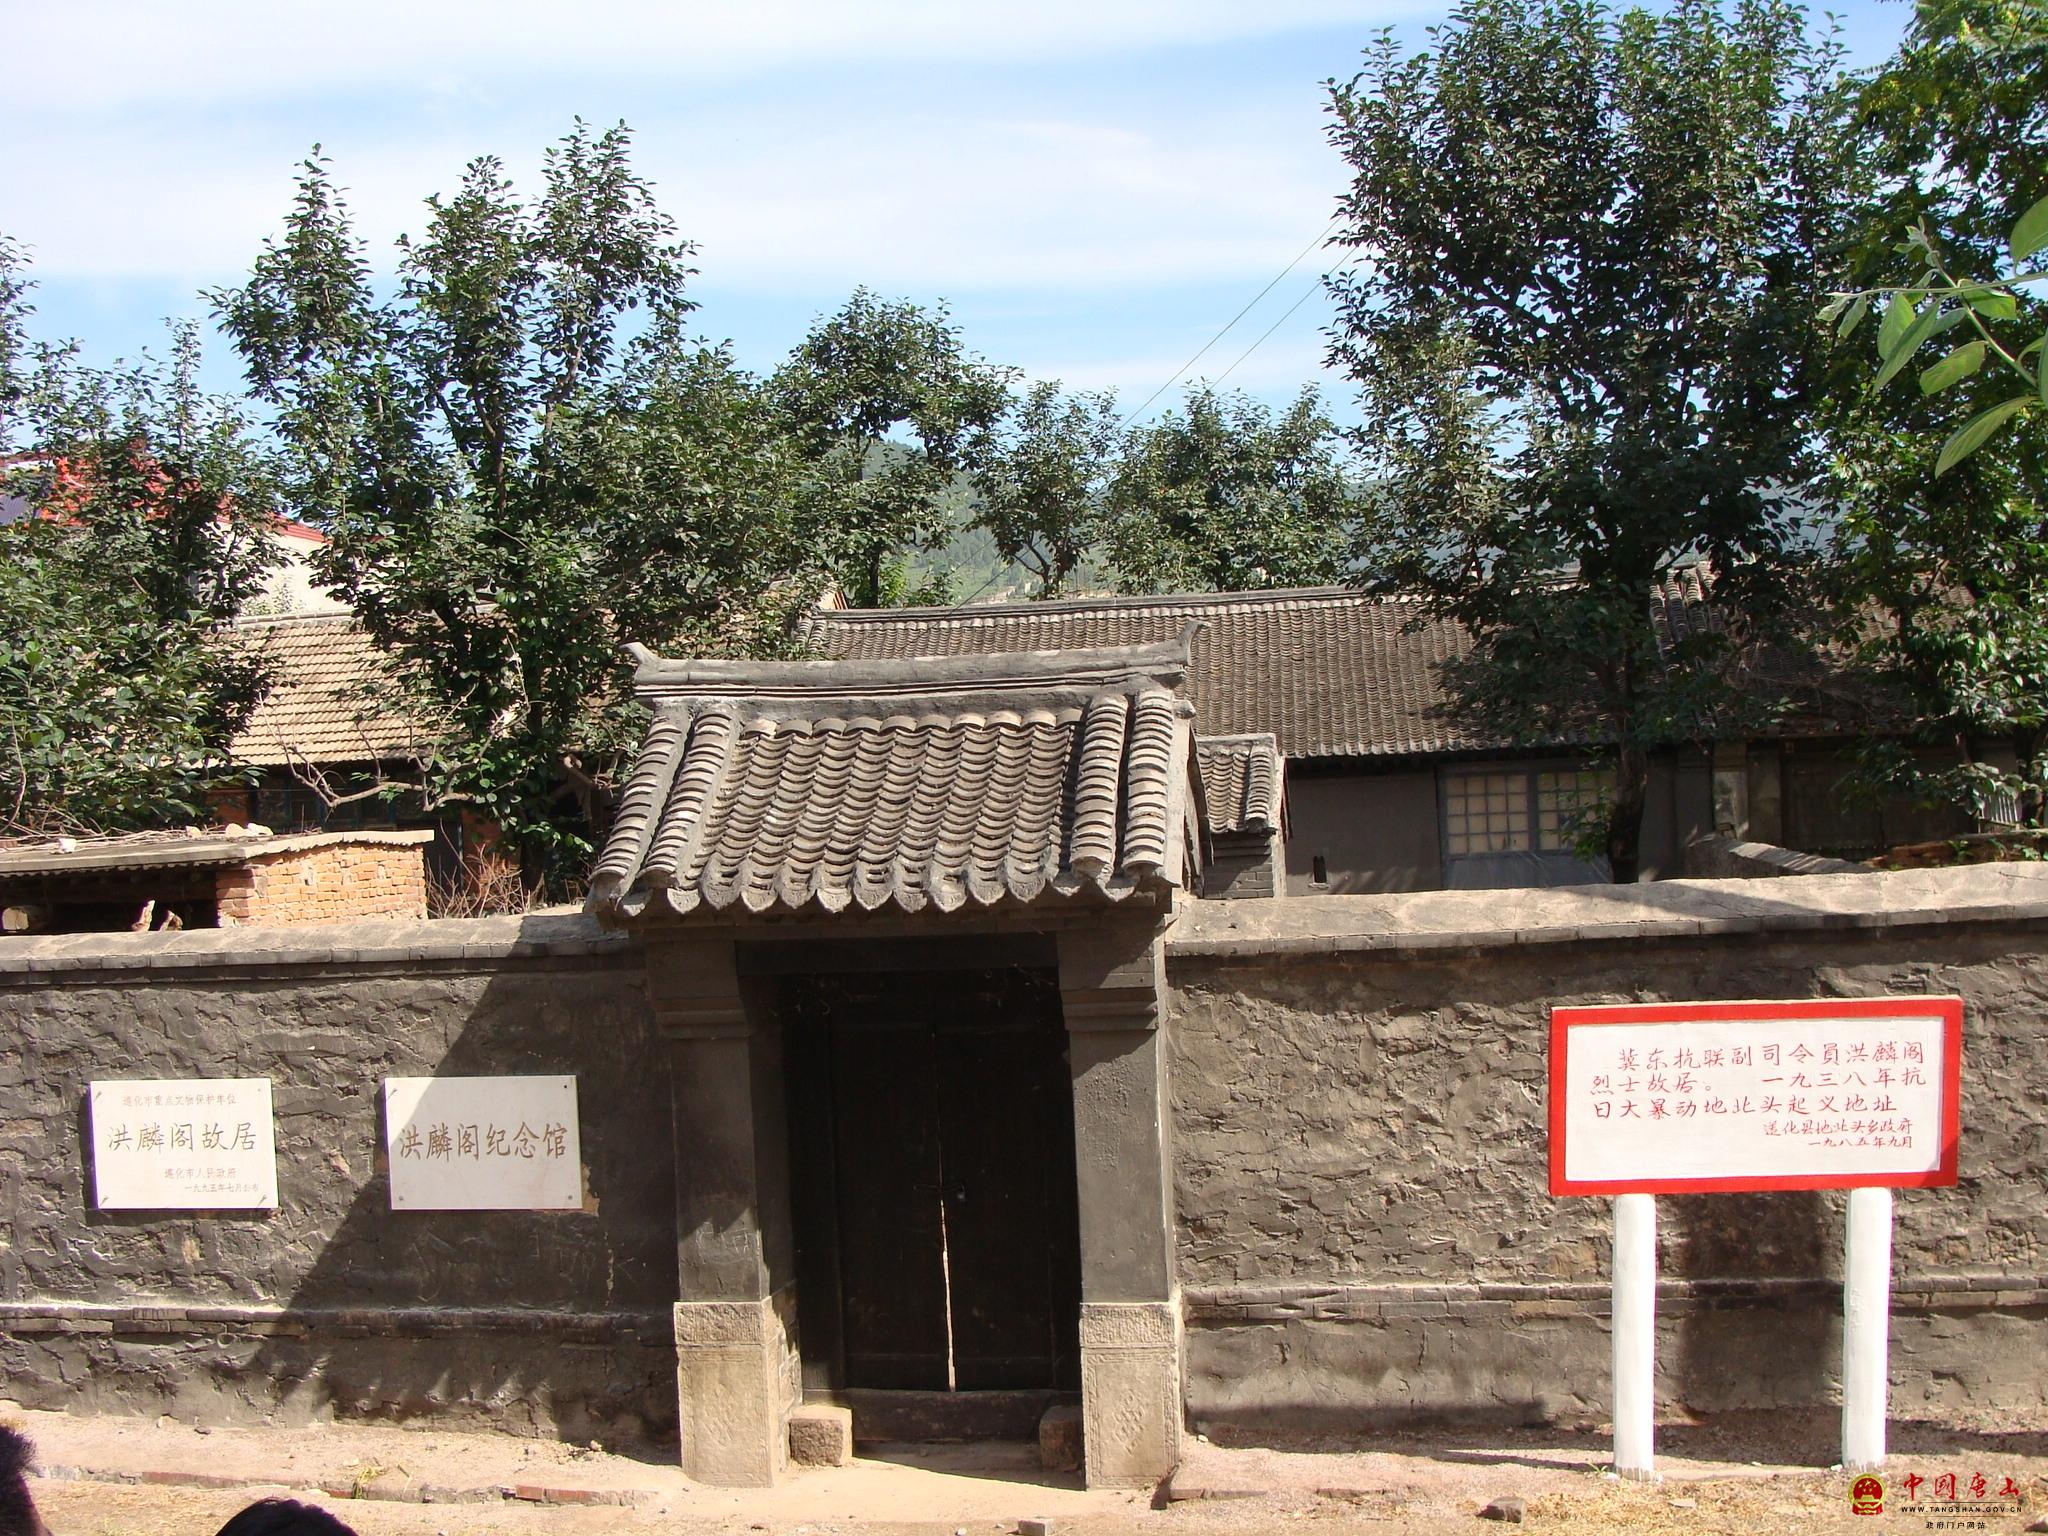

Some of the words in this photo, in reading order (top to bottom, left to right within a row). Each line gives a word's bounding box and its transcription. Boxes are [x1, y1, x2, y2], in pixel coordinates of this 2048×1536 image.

[1590, 1072, 1712, 1096] 烈士故居。
[1761, 1067, 1926, 1088] 一九三八年抗
[1593, 1094, 1898, 1120] 日大暴动地北头起义地址
[108, 1121, 257, 1153] 洪麟阁故居
[399, 1121, 568, 1161] 洪麟阁纪念馆
[1808, 1136, 1913, 1149] 一九八五年九月
